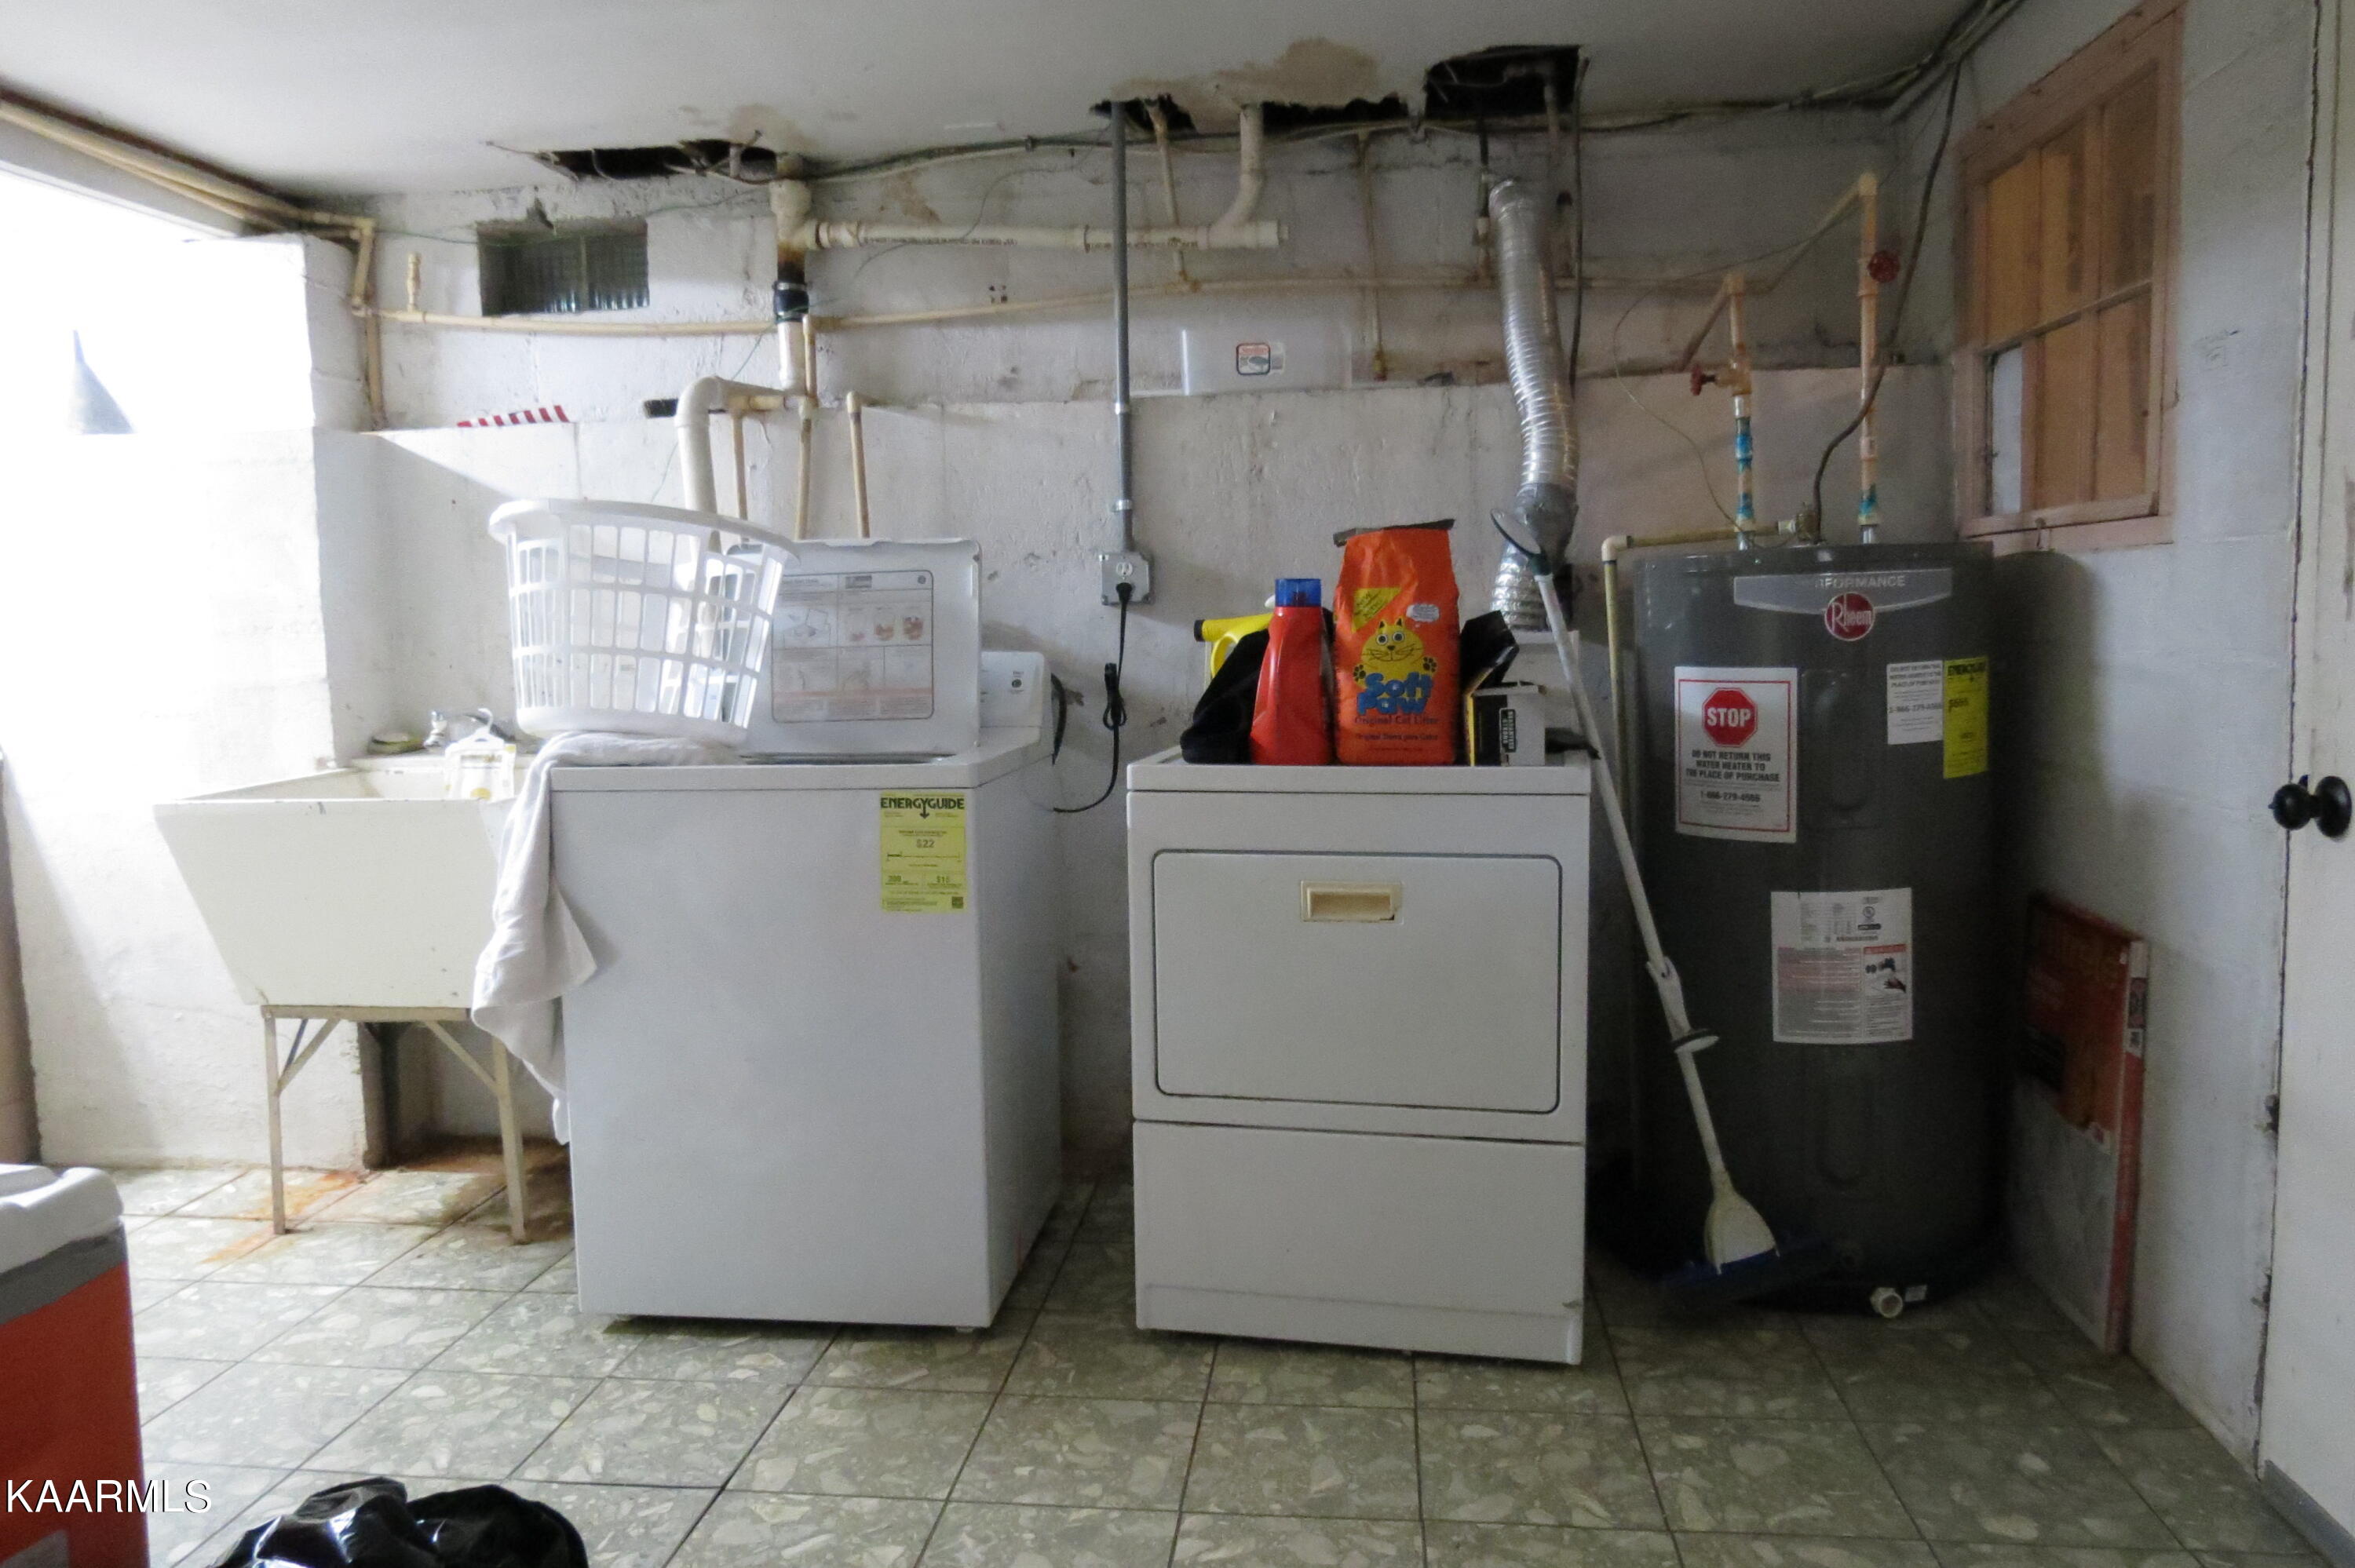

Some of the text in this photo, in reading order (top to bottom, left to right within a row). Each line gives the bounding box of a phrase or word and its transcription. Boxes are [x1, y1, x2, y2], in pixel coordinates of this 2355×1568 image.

[1831, 594, 1872, 633] Rheem
[1365, 672, 1433, 698] Soft
[1356, 691, 1428, 717] Paw
[1707, 708, 1751, 727] STOP
[1703, 750, 1717, 759] NOT
[1719, 751, 1750, 760] RETURN
[1752, 753, 1771, 761] THIS
[1696, 760, 1765, 771] WATER HEATER TO
[1699, 770, 1722, 779] PLACE
[1723, 771, 1733, 780] OF
[1736, 773, 1780, 782] PURCHASE
[880, 797, 965, 809] ENERGYGUIDE
